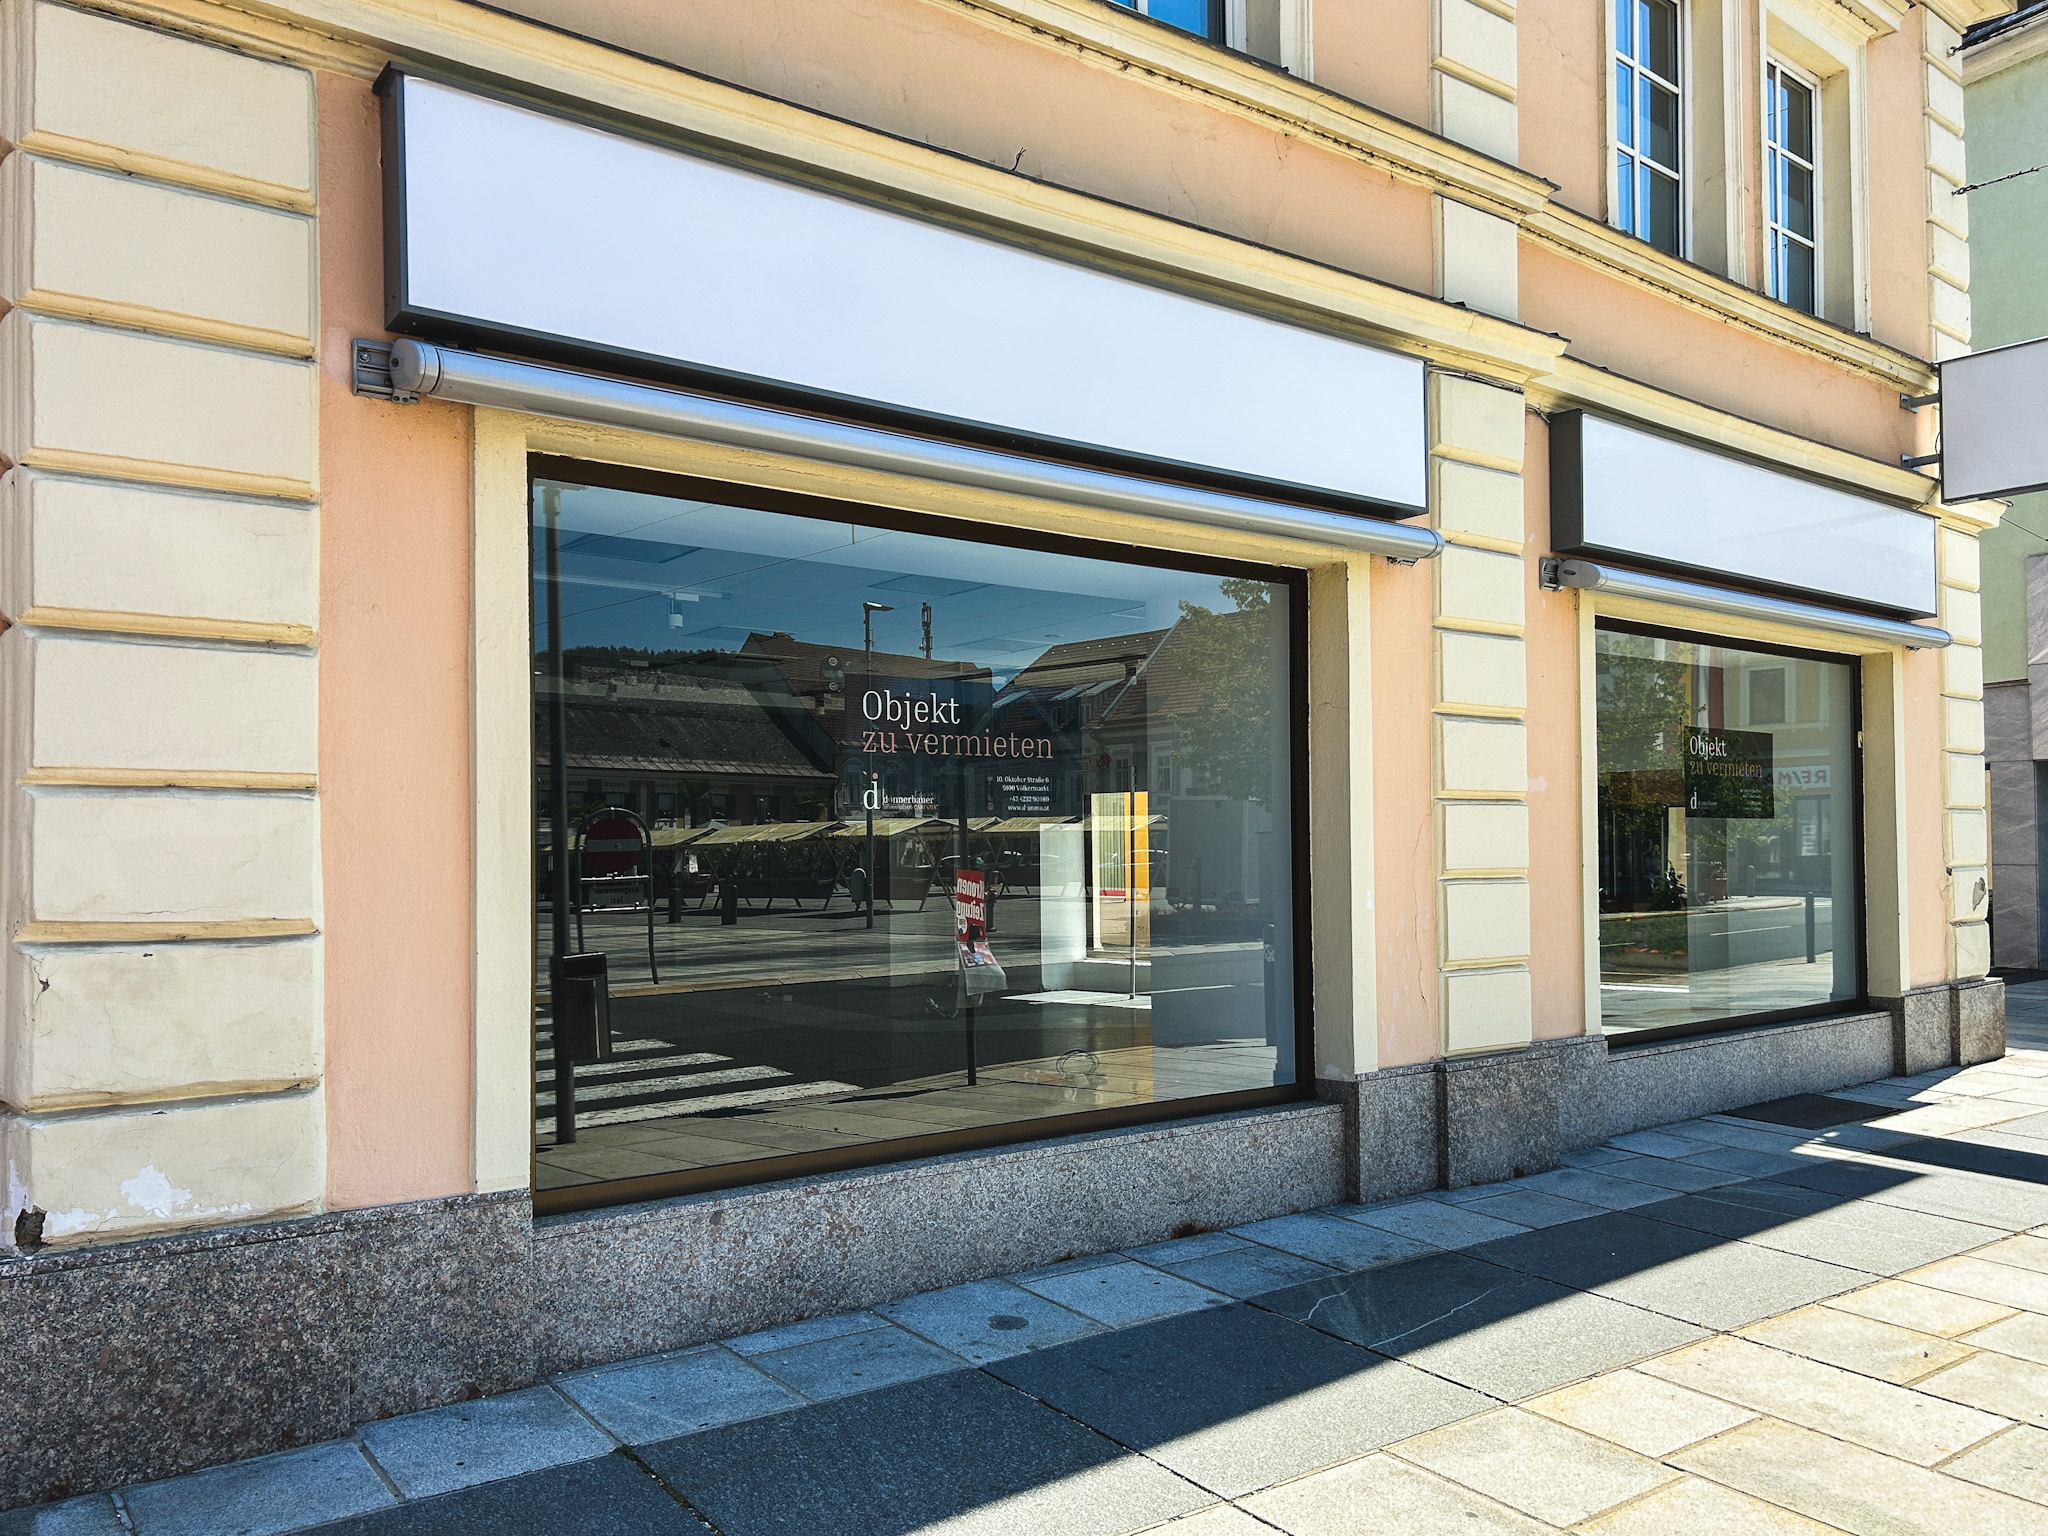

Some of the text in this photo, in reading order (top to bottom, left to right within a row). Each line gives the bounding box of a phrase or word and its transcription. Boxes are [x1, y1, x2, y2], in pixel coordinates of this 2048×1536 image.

[862, 690, 960, 730] Objekt
[862, 728, 1054, 759] zu vermieten
[1689, 735, 1727, 760] Objekt
[1689, 760, 1763, 778] zu vermieten
